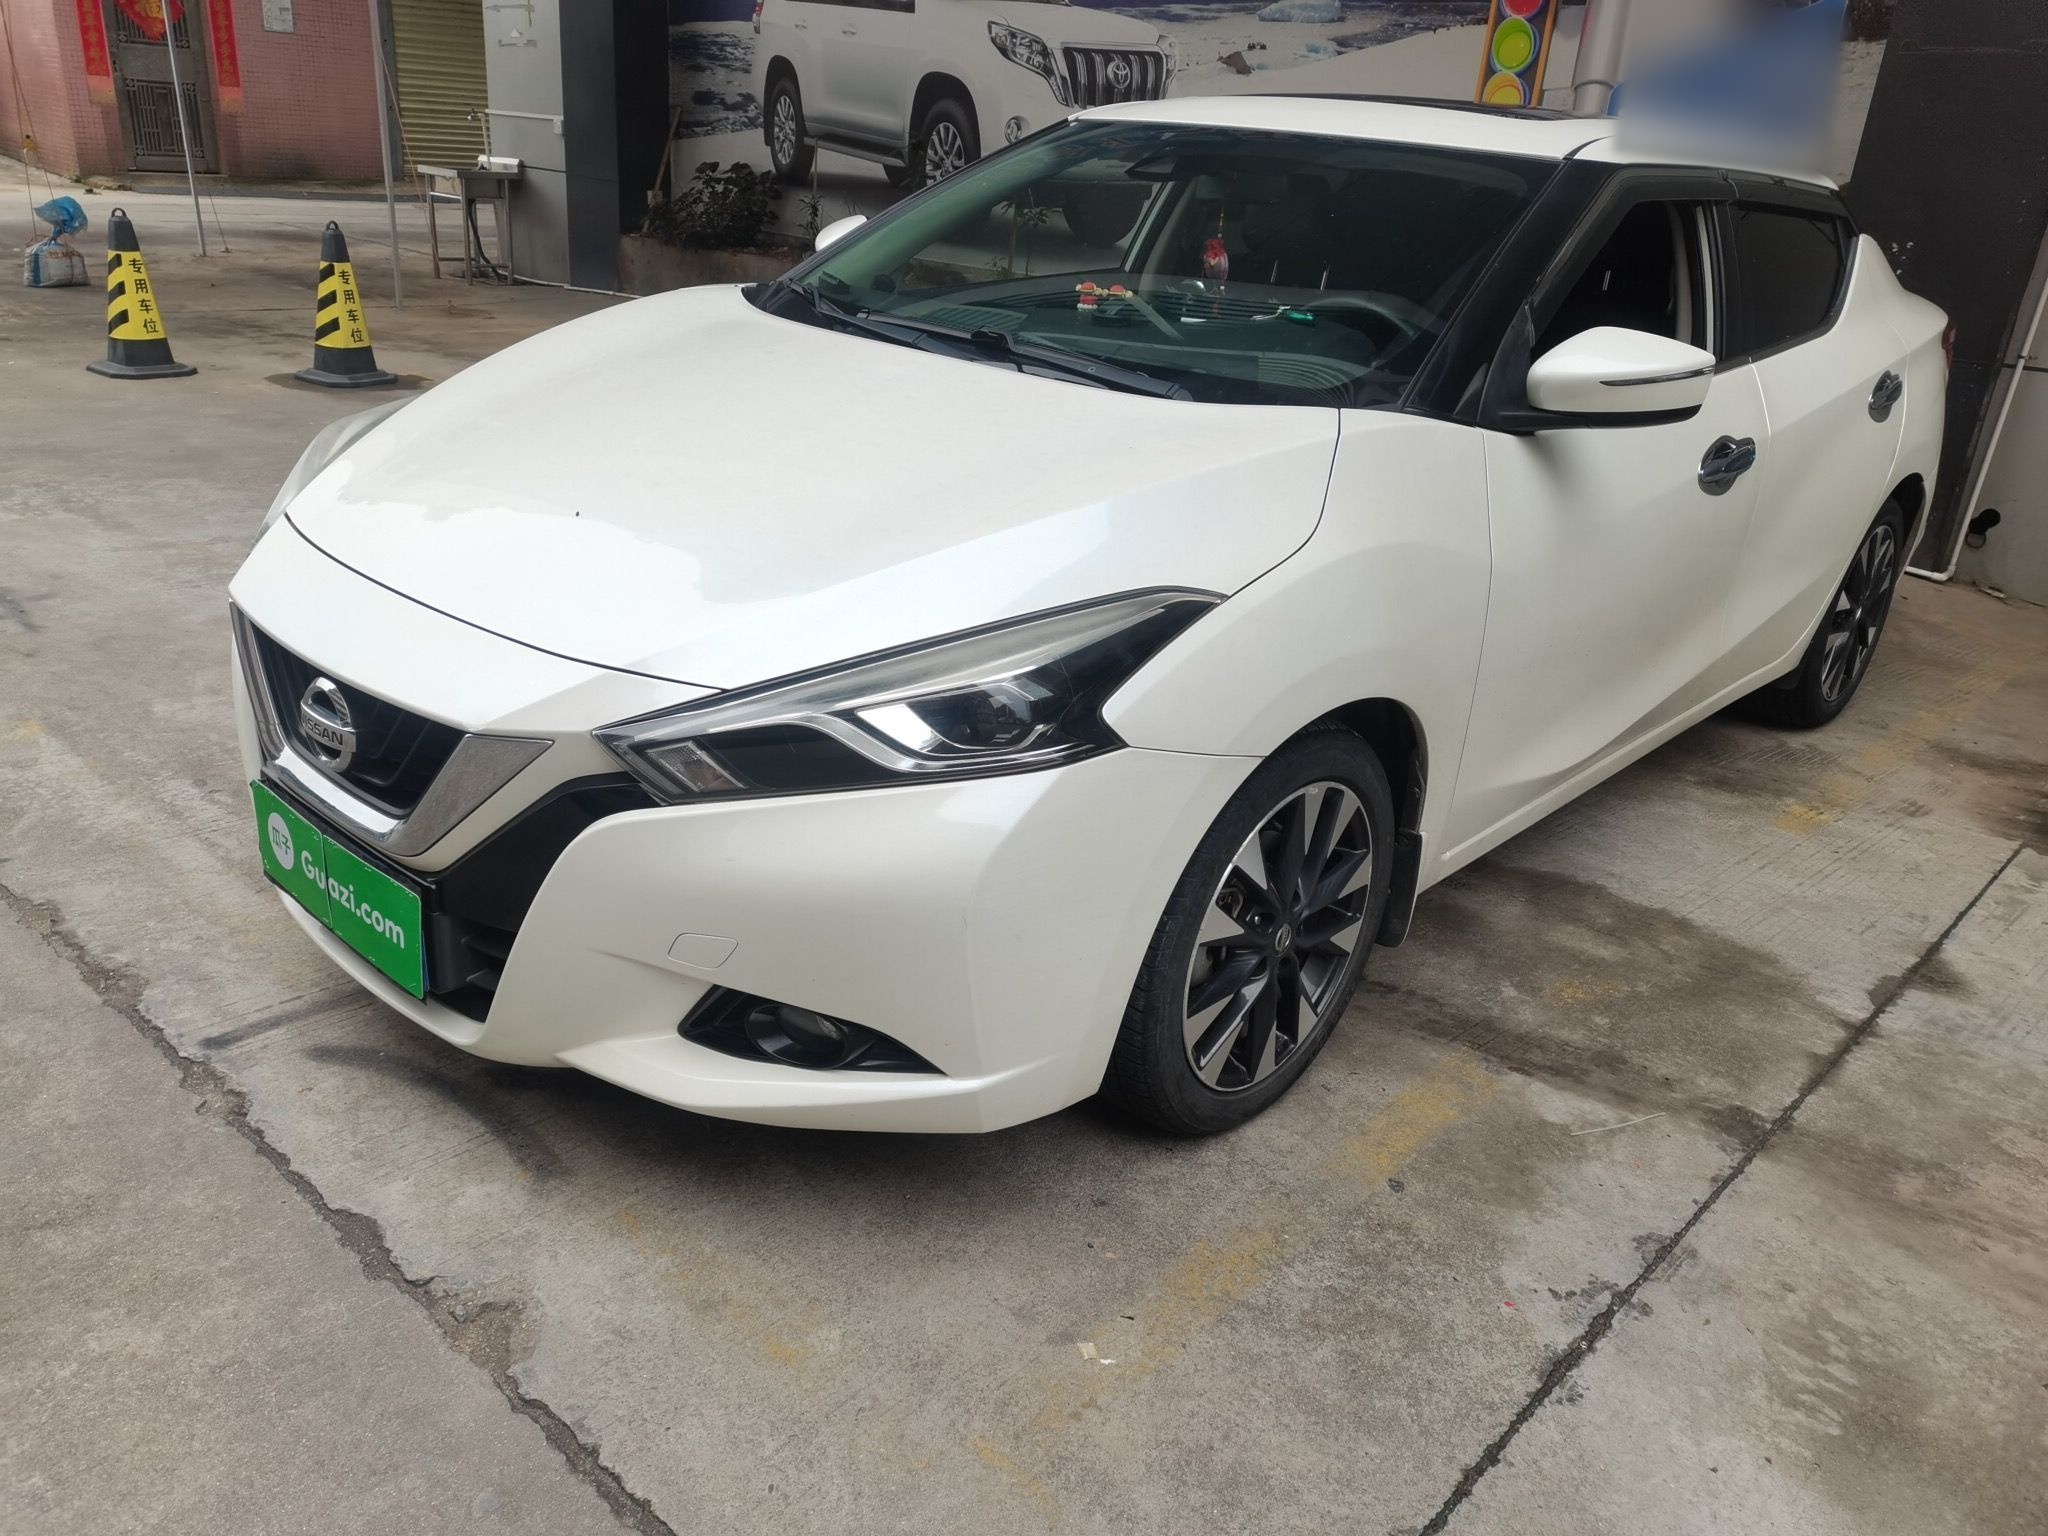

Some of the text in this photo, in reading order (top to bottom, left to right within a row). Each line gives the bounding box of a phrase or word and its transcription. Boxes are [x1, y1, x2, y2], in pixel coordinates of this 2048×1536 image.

[128, 258, 159, 334] 专用车位
[338, 269, 364, 343] 专用车位
[272, 826, 291, 855] 瓜子
[301, 850, 405, 949] Guazi.com
